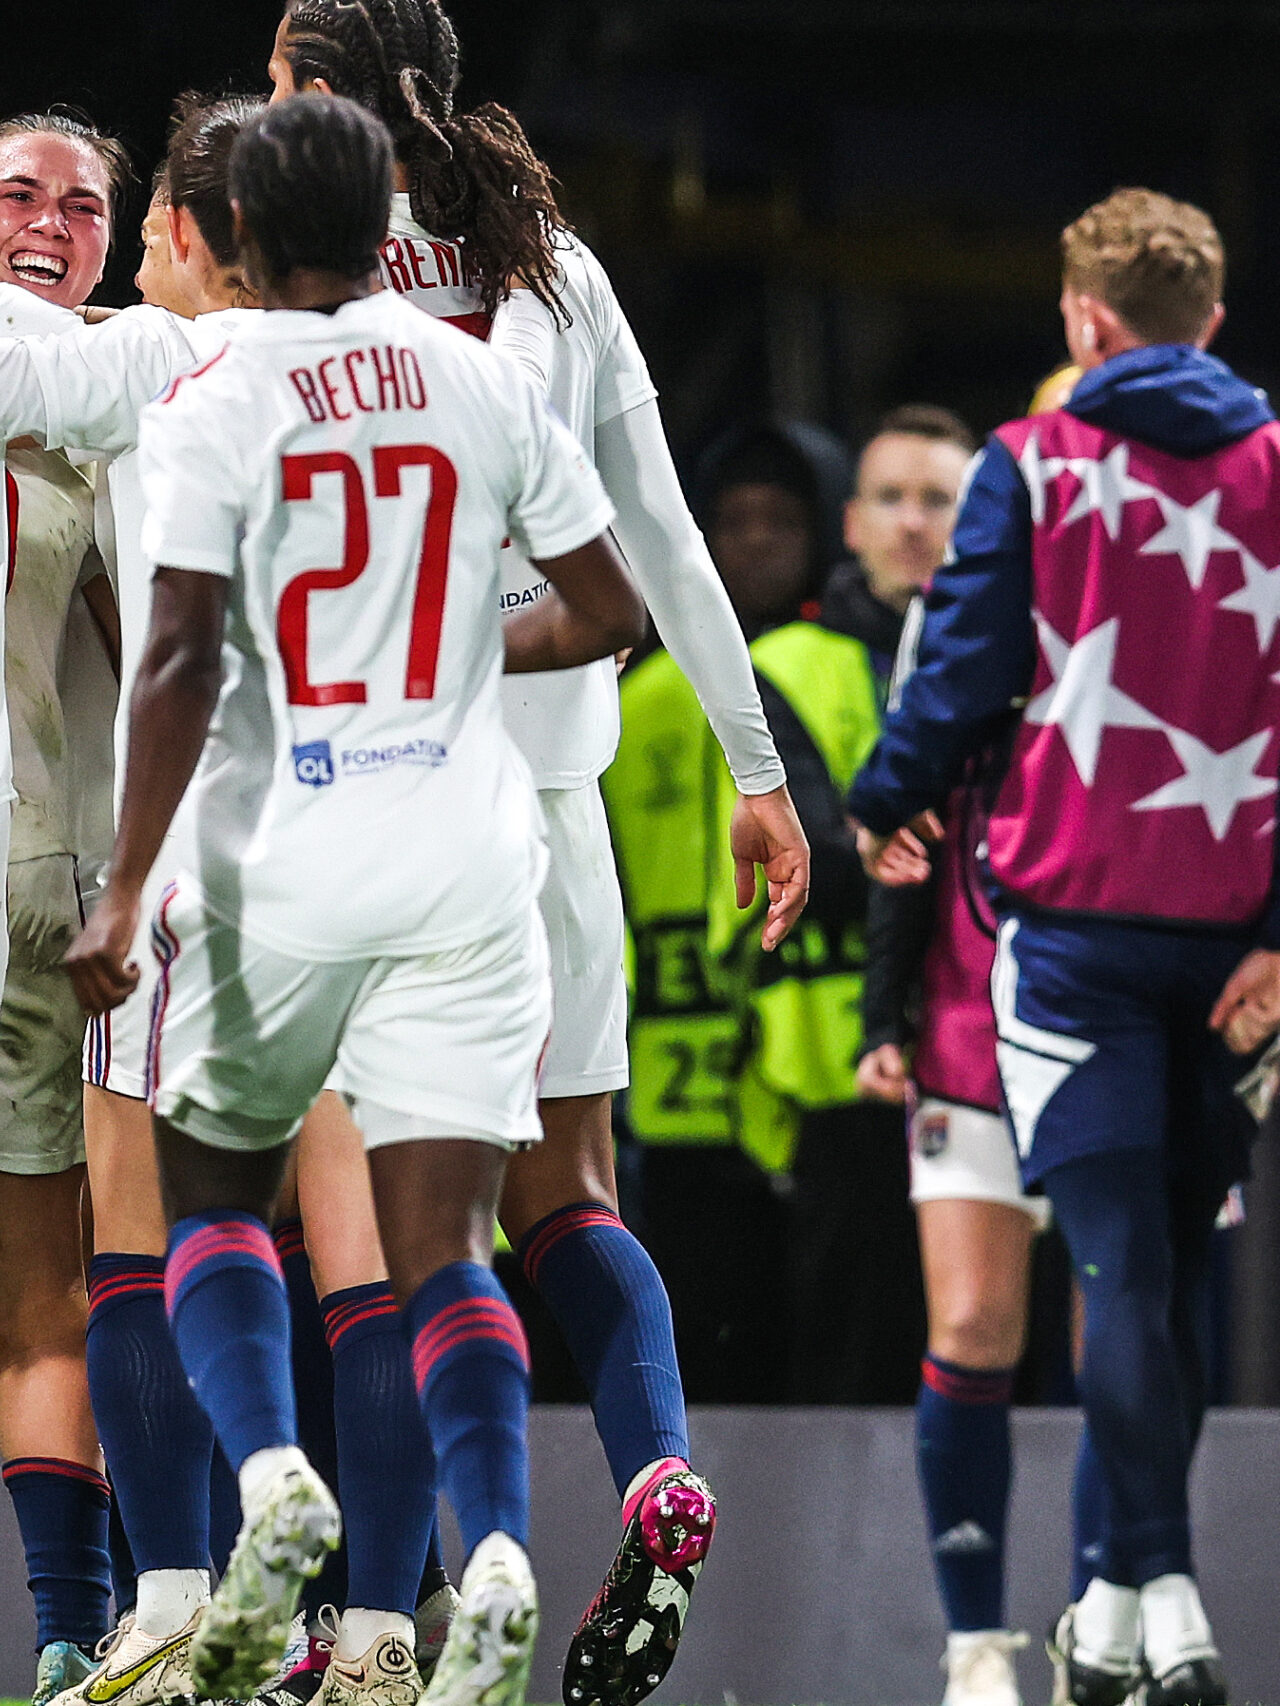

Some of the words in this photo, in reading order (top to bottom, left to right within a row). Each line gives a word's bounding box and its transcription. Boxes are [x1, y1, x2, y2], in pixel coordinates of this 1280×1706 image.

[379, 238, 464, 293] REN
[289, 346, 426, 422] BECHO
[277, 444, 457, 706] 27
